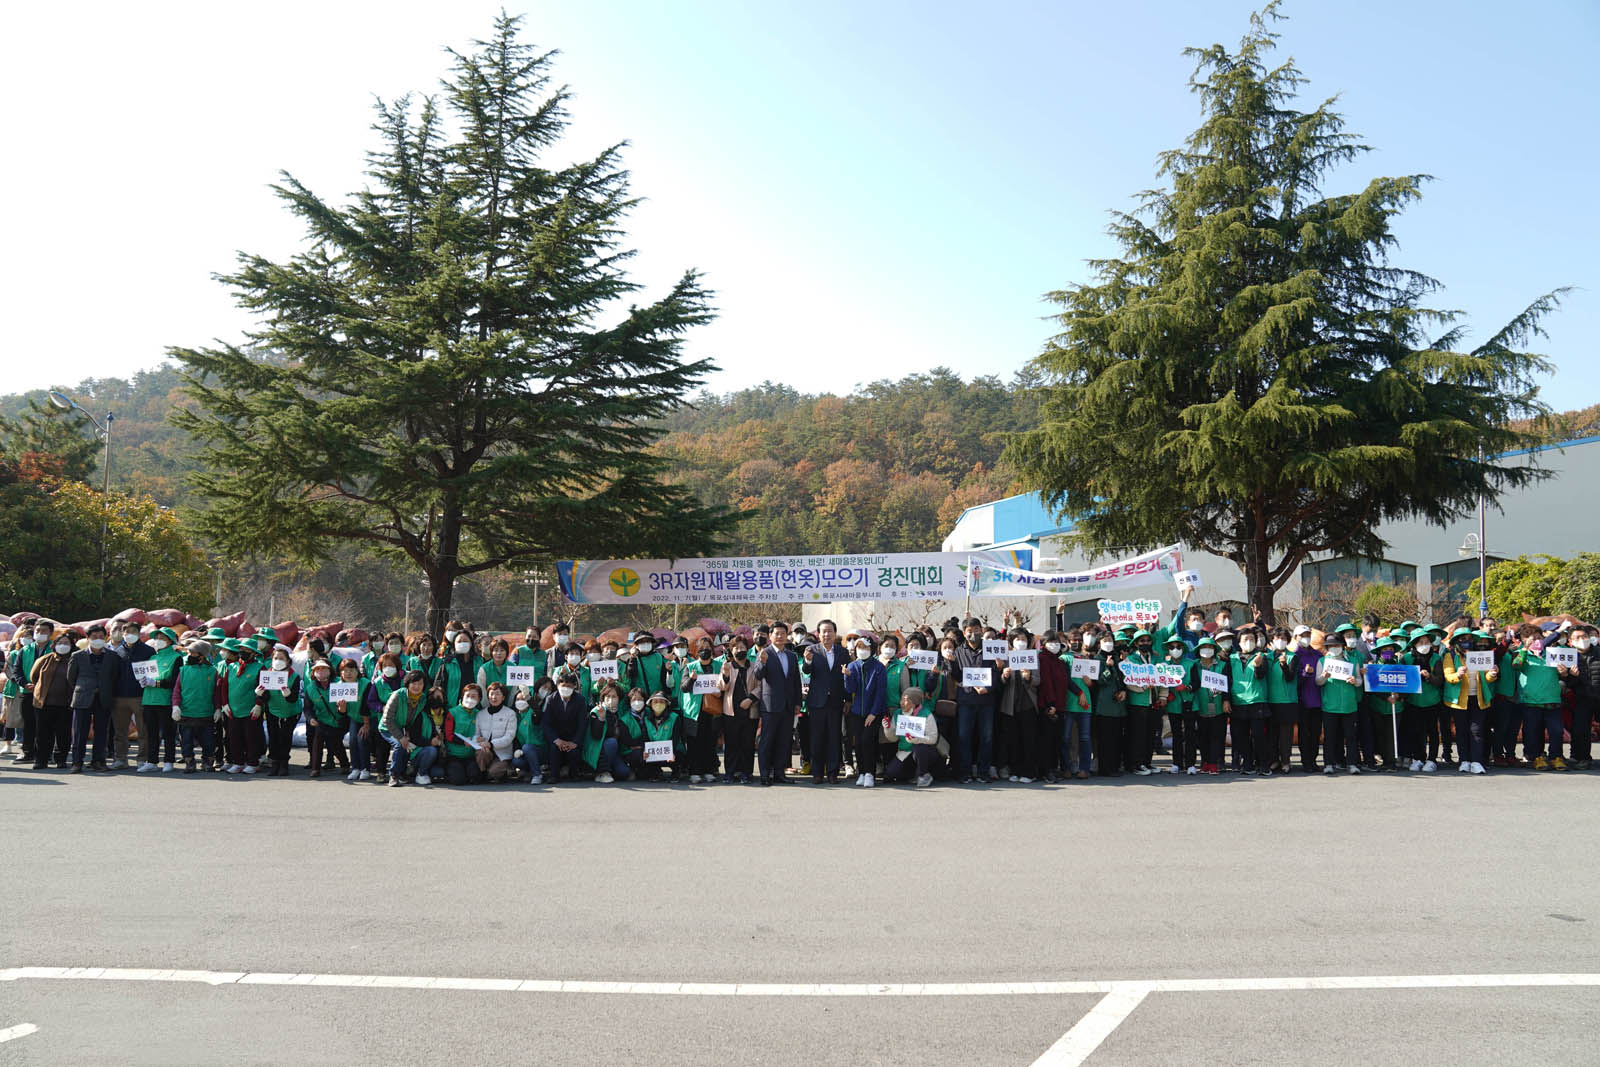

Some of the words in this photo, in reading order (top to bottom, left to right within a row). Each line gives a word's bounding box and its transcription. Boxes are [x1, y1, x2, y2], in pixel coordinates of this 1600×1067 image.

[731, 559, 753, 568] 자원을
[756, 558, 786, 568] 절약하는
[808, 557, 825, 566] 바로!
[992, 569, 1013, 583] 3R
[1122, 557, 1161, 577] 모으기
[648, 567, 869, 591] 3R자원재활용품(헌옷)모으기
[877, 566, 943, 587] 경진대회
[822, 591, 882, 599] 목포시새마을부녀회
[1134, 600, 1160, 612] 하당동
[1103, 613, 1133, 622] 사랑해요
[1135, 612, 1151, 622] 목포
[985, 646, 1006, 655] 북항동
[1011, 655, 1035, 664] 이로동
[1469, 656, 1492, 665] 옥암동
[1549, 653, 1575, 663] 부흥동
[133, 664, 157, 676] 용당1동
[593, 666, 615, 675] 연산동
[1089, 665, 1097, 674] 동
[1156, 664, 1183, 676] 하당동
[1326, 663, 1350, 676] 삼향동
[509, 672, 530, 682] 원산동
[1125, 675, 1156, 686] 사랑해요
[1158, 675, 1176, 685] 목포
[1204, 675, 1226, 688] 하당동
[1378, 673, 1406, 684] 옥암동
[694, 680, 718, 689] 목원동
[331, 688, 356, 697] 용당2동
[647, 746, 671, 756] 대성동
